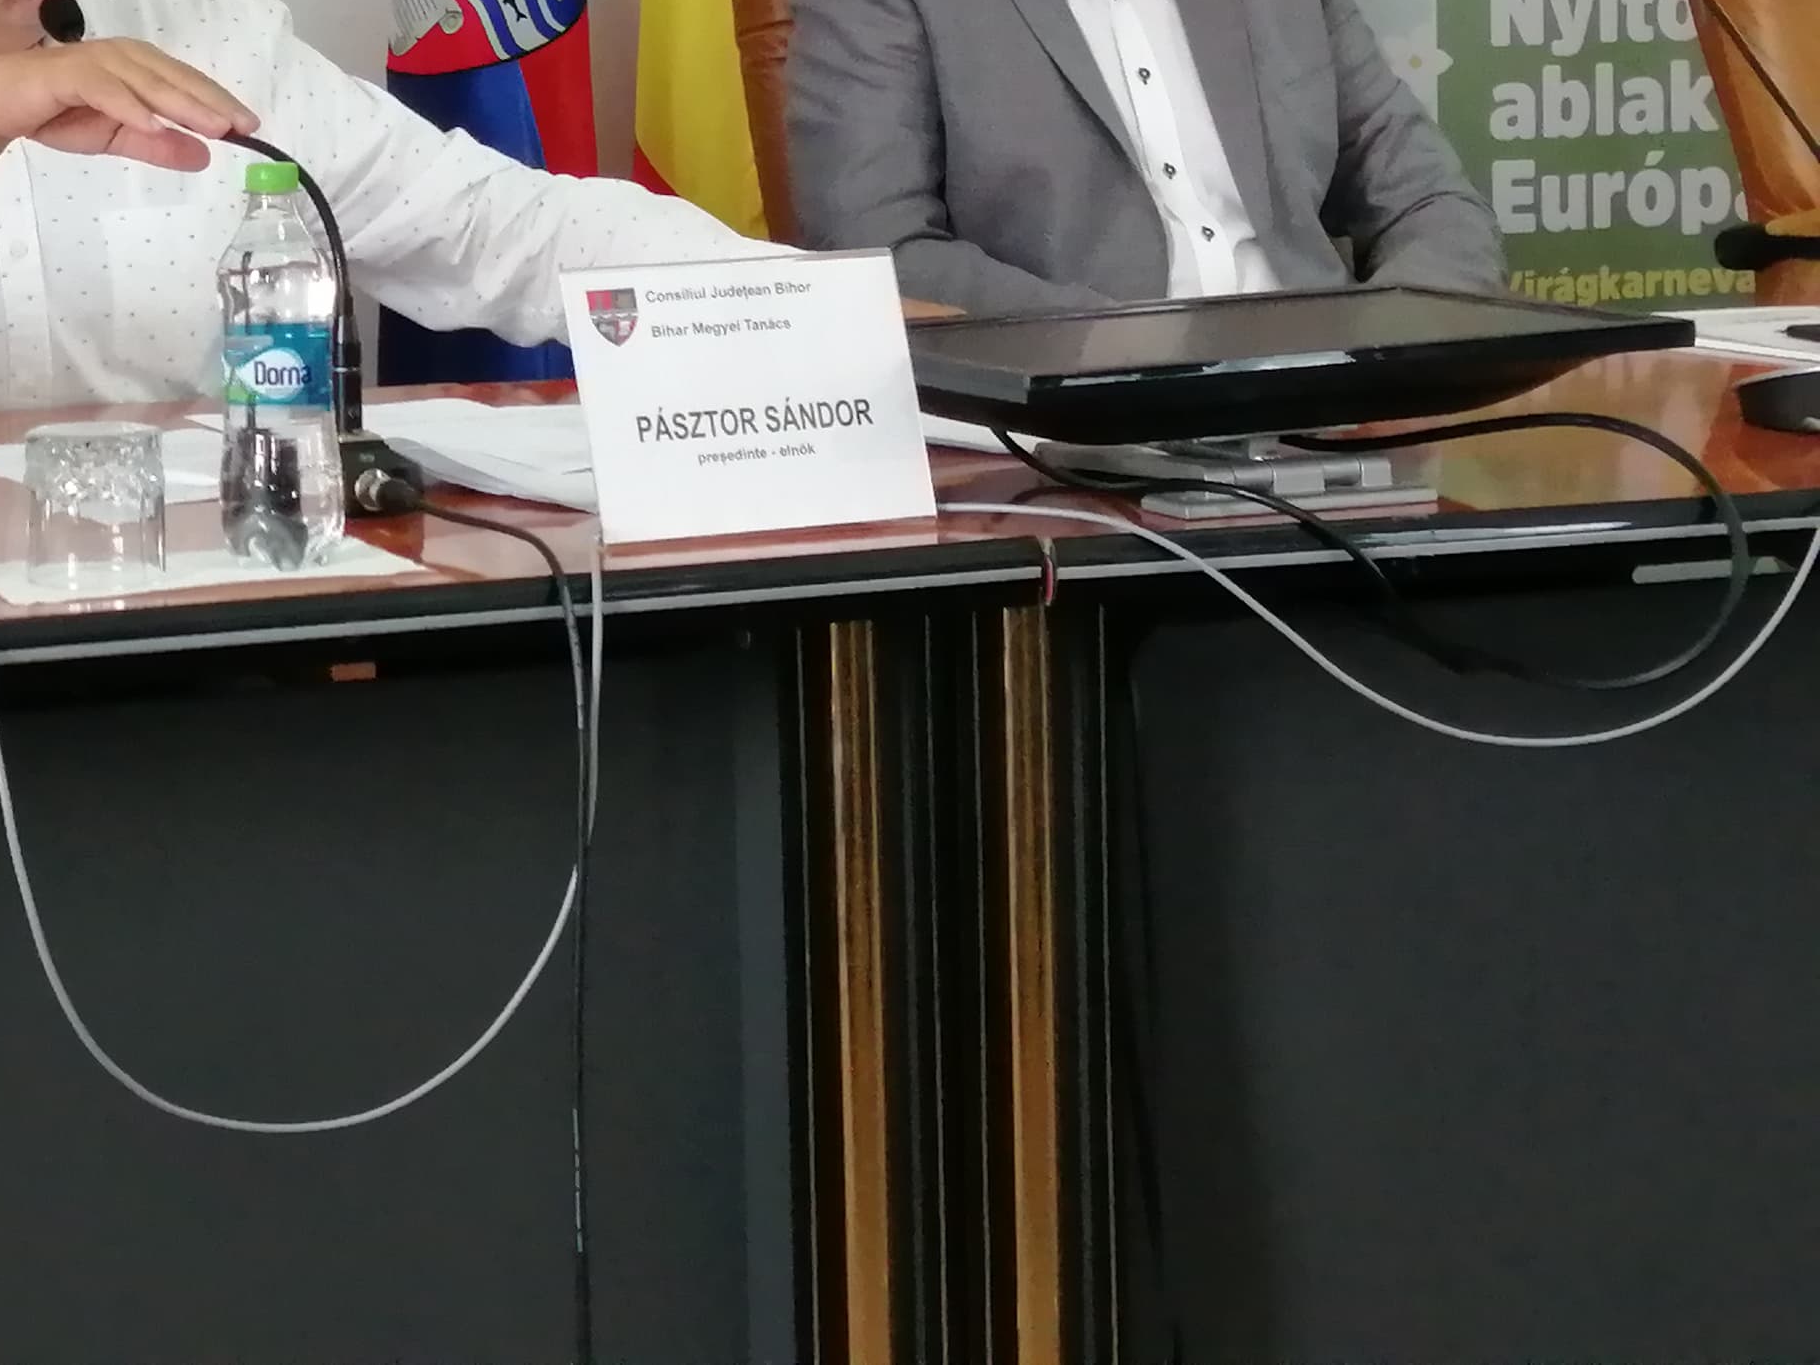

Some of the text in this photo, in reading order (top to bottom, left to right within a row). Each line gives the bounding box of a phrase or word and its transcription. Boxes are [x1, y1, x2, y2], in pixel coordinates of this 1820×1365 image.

[1489, 59, 1721, 141] ablak
[645, 281, 812, 303] Consiliul Județean Bihor
[651, 317, 792, 338] Bihar Megyei Tanács
[254, 360, 313, 386] Dorna
[636, 396, 874, 443] PÁSZTOR SÁNDOR
[697, 447, 768, 466] președinte
